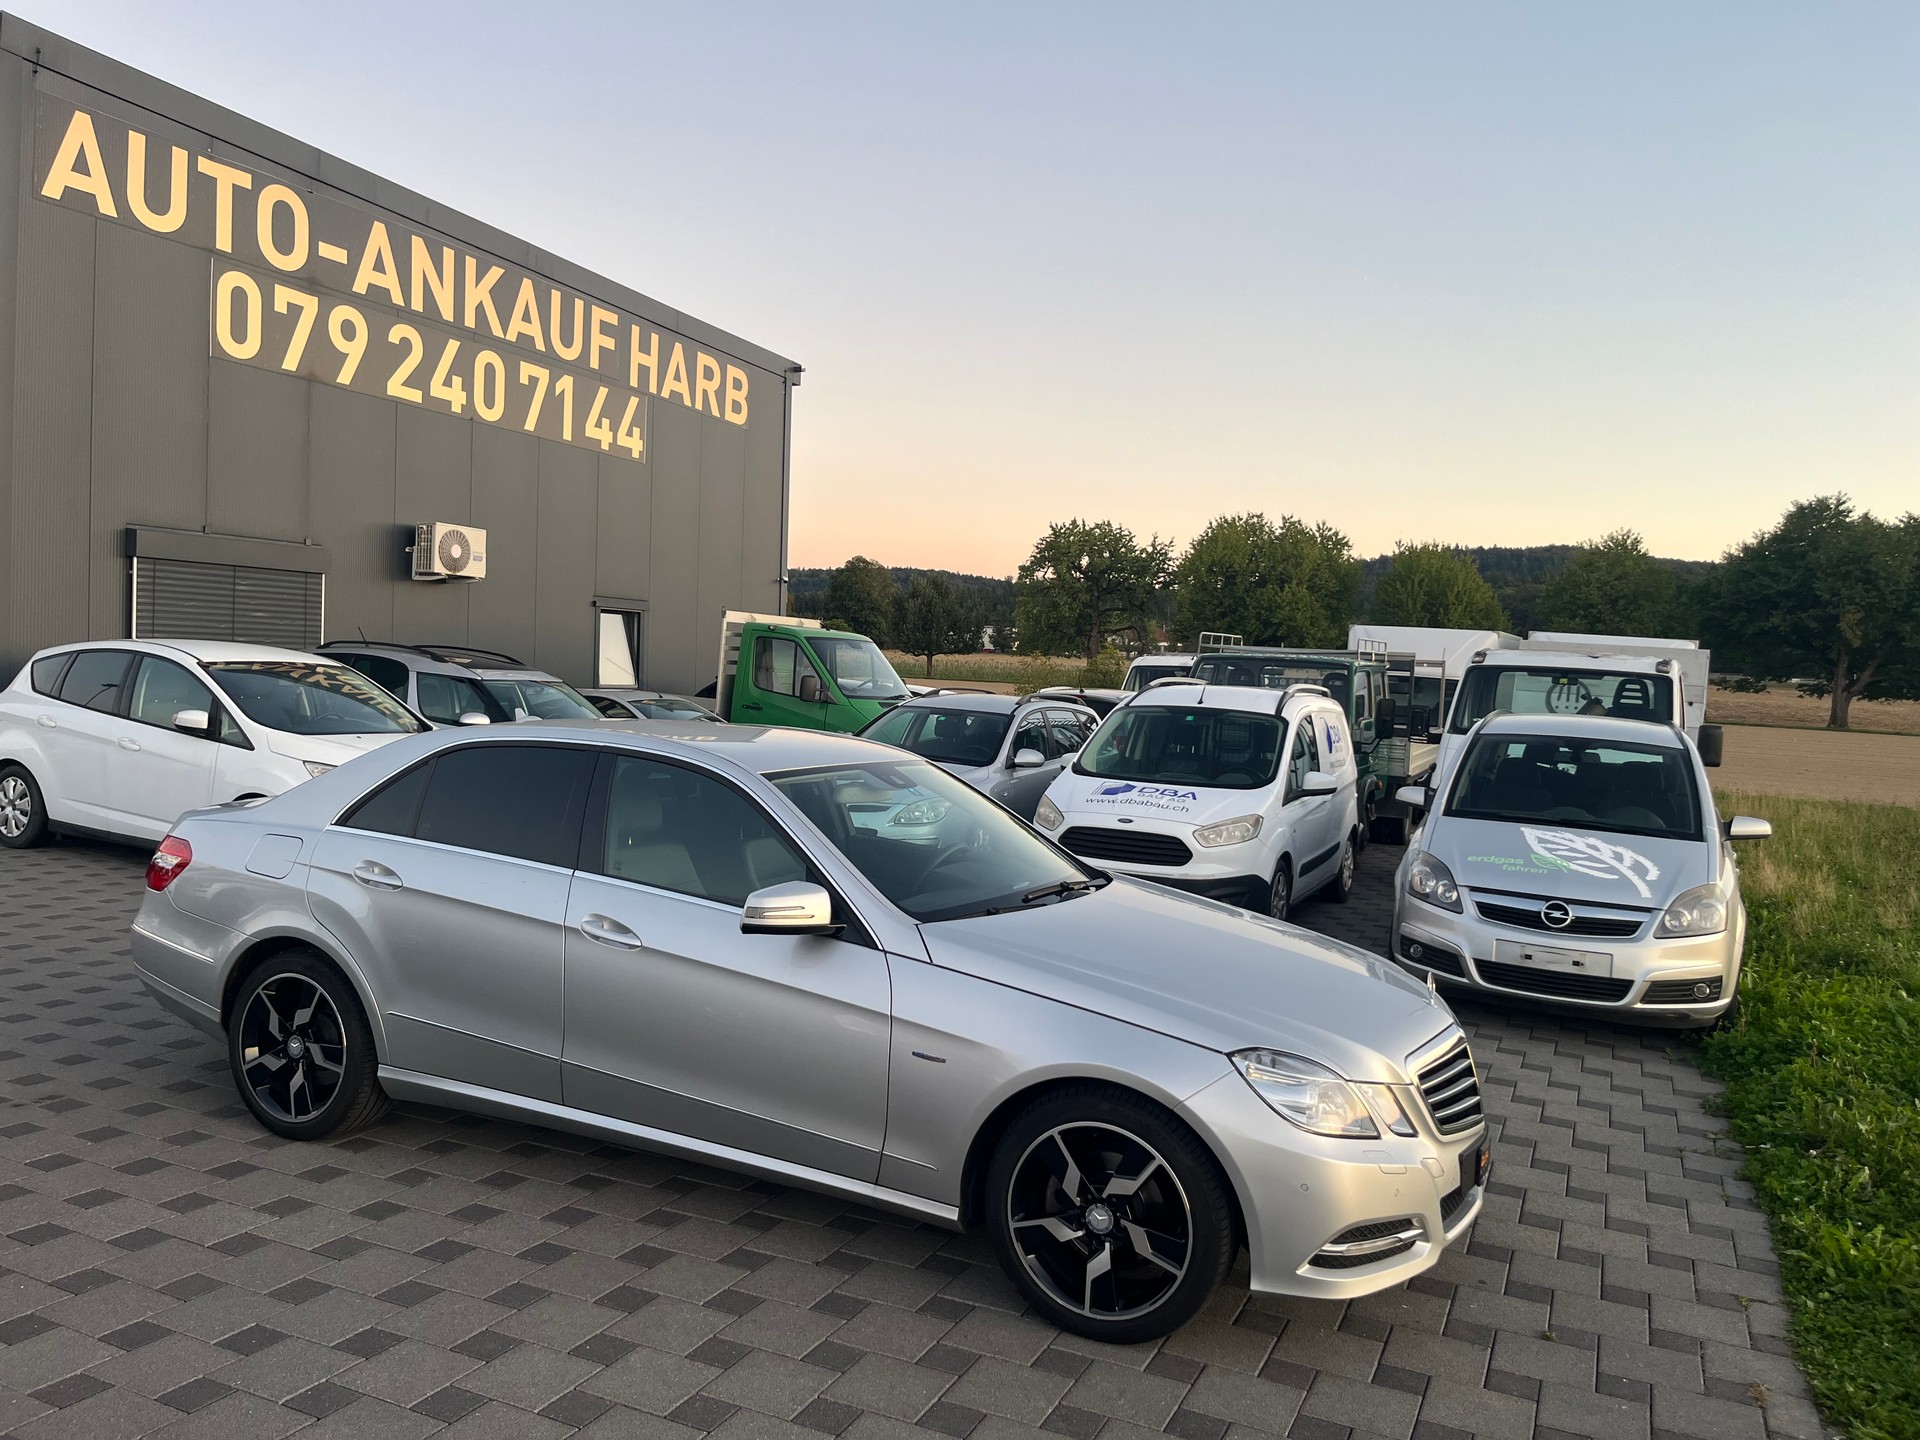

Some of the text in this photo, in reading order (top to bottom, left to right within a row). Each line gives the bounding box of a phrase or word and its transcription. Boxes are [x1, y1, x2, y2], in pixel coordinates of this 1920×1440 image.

[40, 110, 749, 427] AUTO-ANKAUF HARB
[216, 270, 369, 386] 079
[386, 323, 506, 423] 240
[1137, 786, 1198, 801] DBA
[1085, 798, 1190, 813] www.dbabau.ch
[1467, 855, 1525, 865] erdgas
[1502, 864, 1548, 874] fahren
